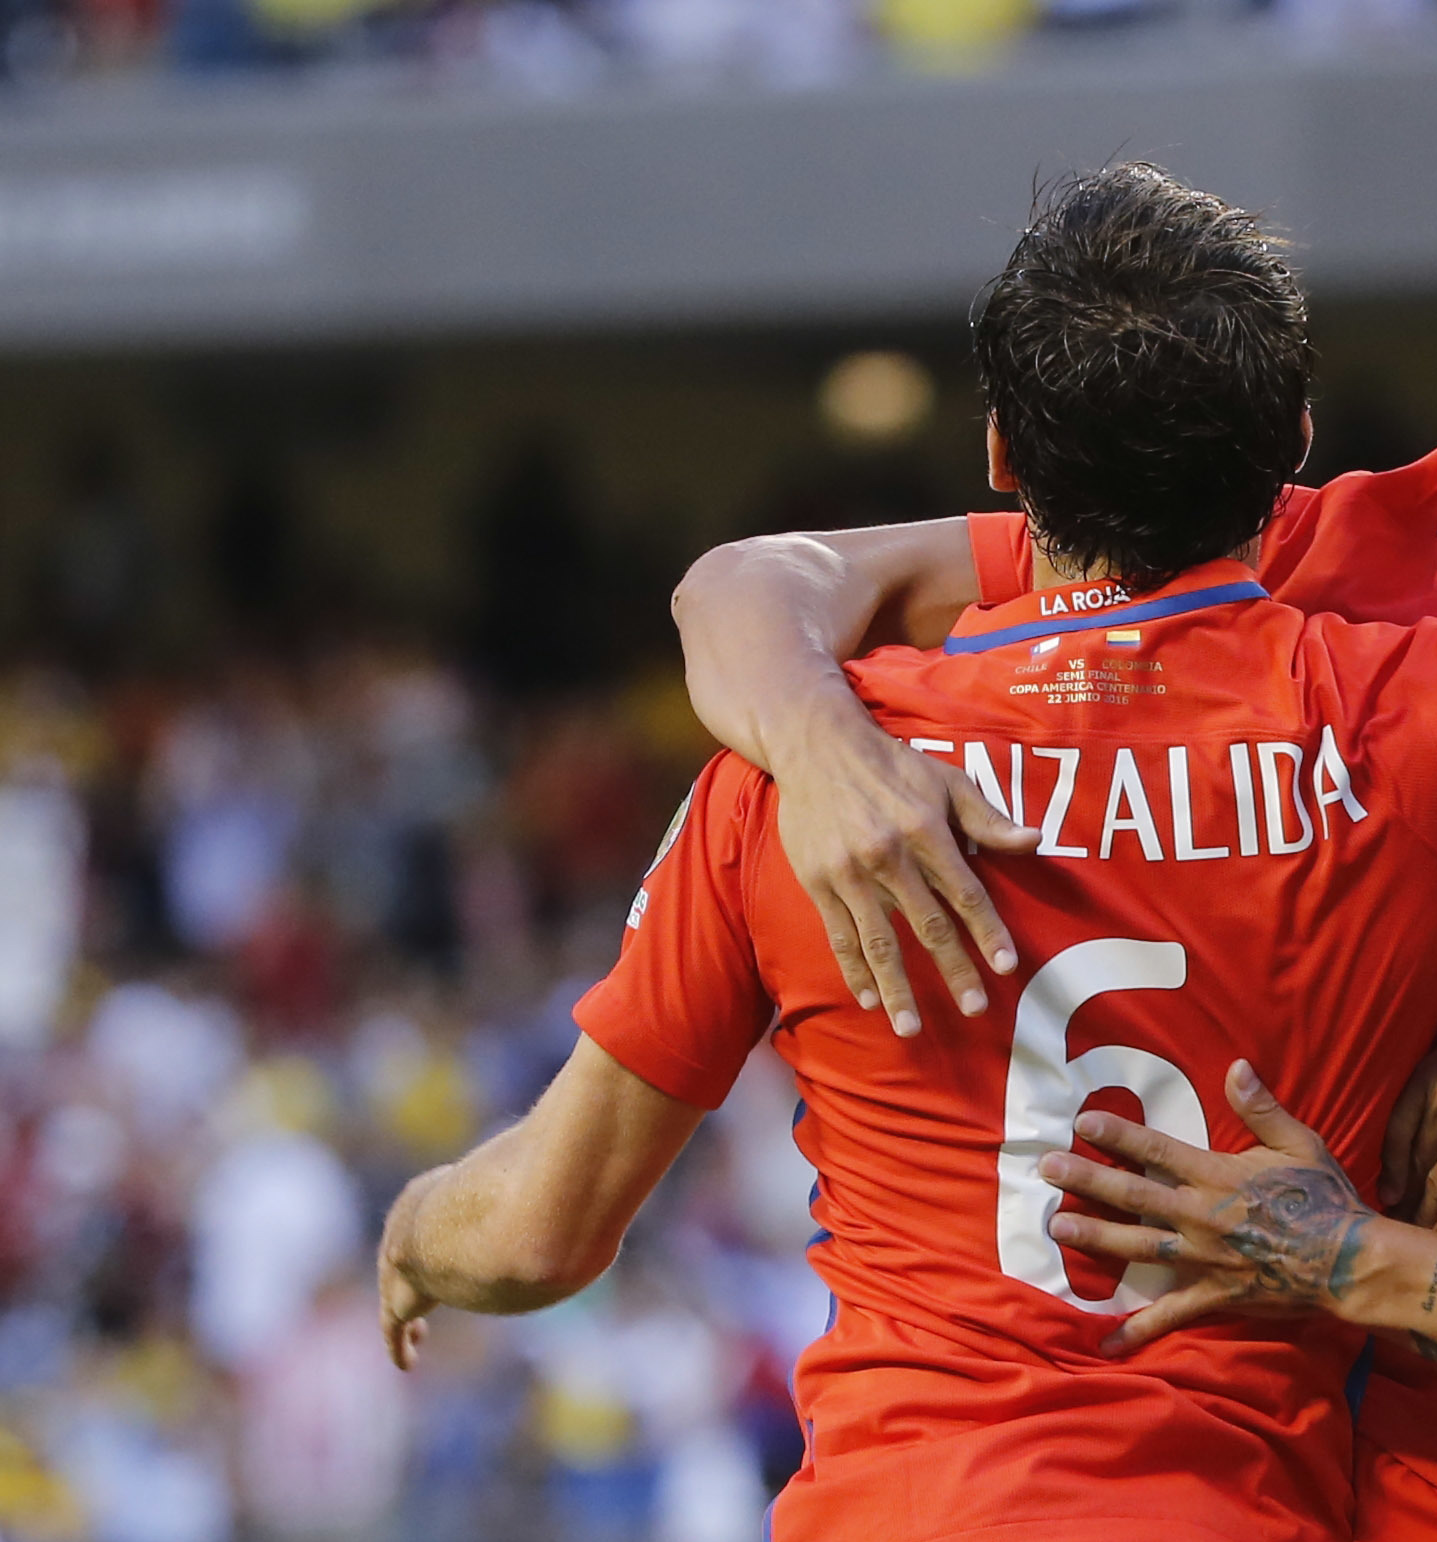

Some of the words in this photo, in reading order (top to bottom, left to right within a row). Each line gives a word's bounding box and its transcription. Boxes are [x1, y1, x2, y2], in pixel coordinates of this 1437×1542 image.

[1040, 593, 1069, 616] LA
[1071, 585, 1131, 610] ROJA
[1015, 663, 1048, 674] CHILE
[1068, 659, 1085, 670] VS
[1056, 670, 1086, 681] SEMI
[1088, 670, 1121, 682] FINAL
[1009, 684, 1039, 695] COPA
[1041, 681, 1094, 692] AMERICA
[1096, 682, 1167, 695] CENTENARIO
[1047, 694, 1062, 704] 22
[1065, 692, 1101, 703] JUNIO
[898, 724, 1369, 862] NZALIDA
[997, 937, 1209, 1317] 6
